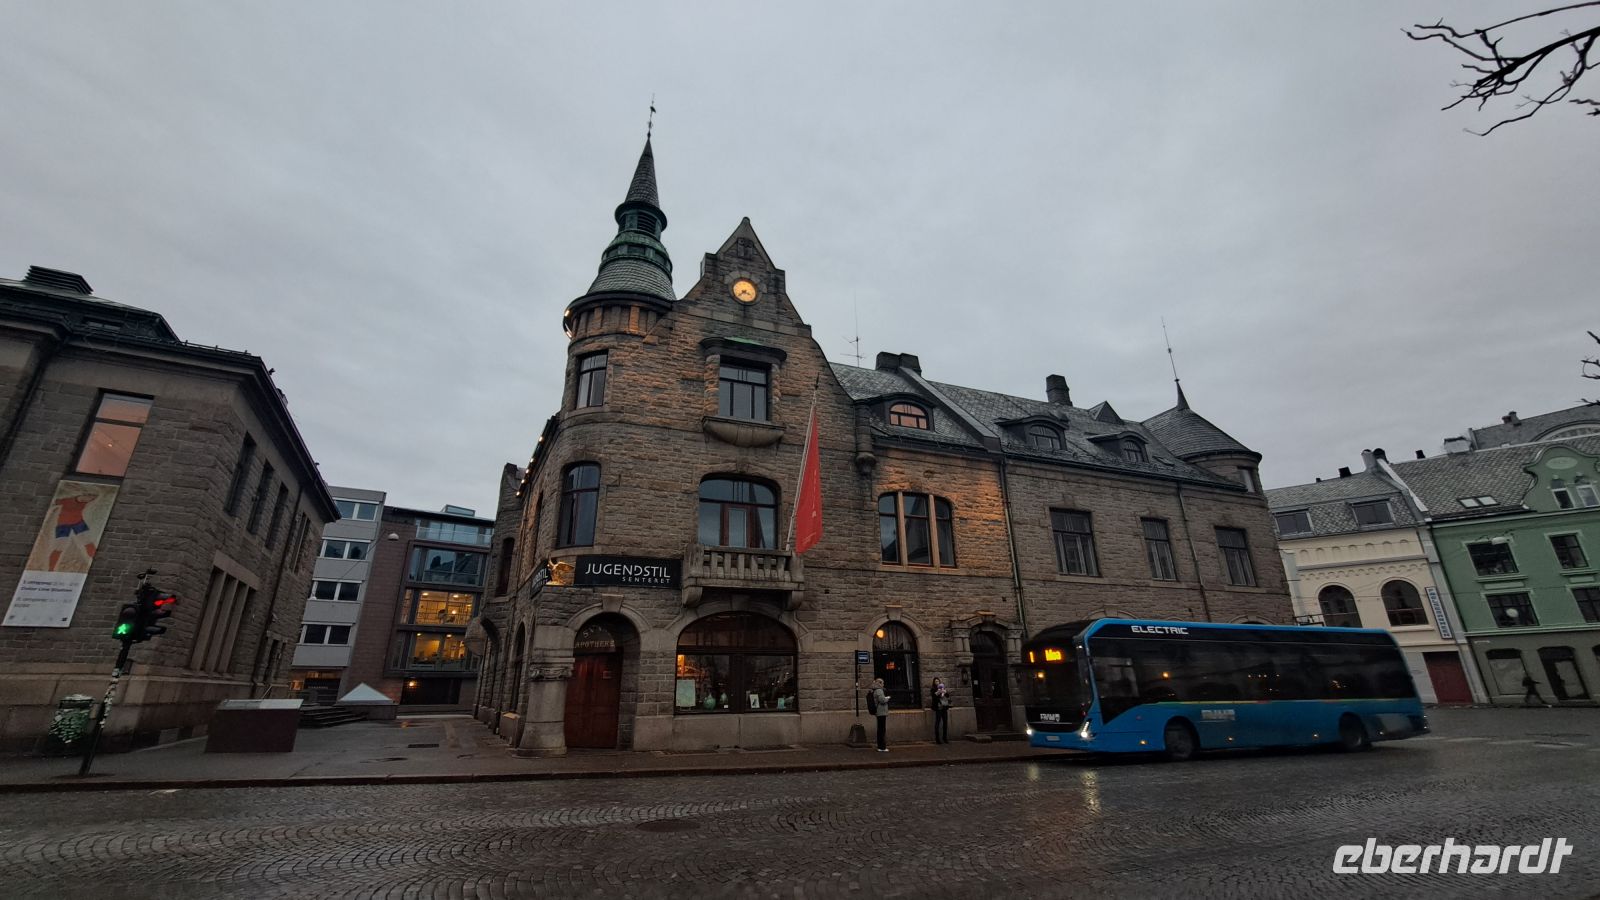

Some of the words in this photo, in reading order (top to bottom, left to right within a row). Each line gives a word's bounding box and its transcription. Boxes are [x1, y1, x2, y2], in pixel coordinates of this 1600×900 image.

[585, 563, 671, 578] JUGENDSTIL
[622, 576, 670, 584] SENTERET
[1131, 625, 1189, 635] ELECTRIC
